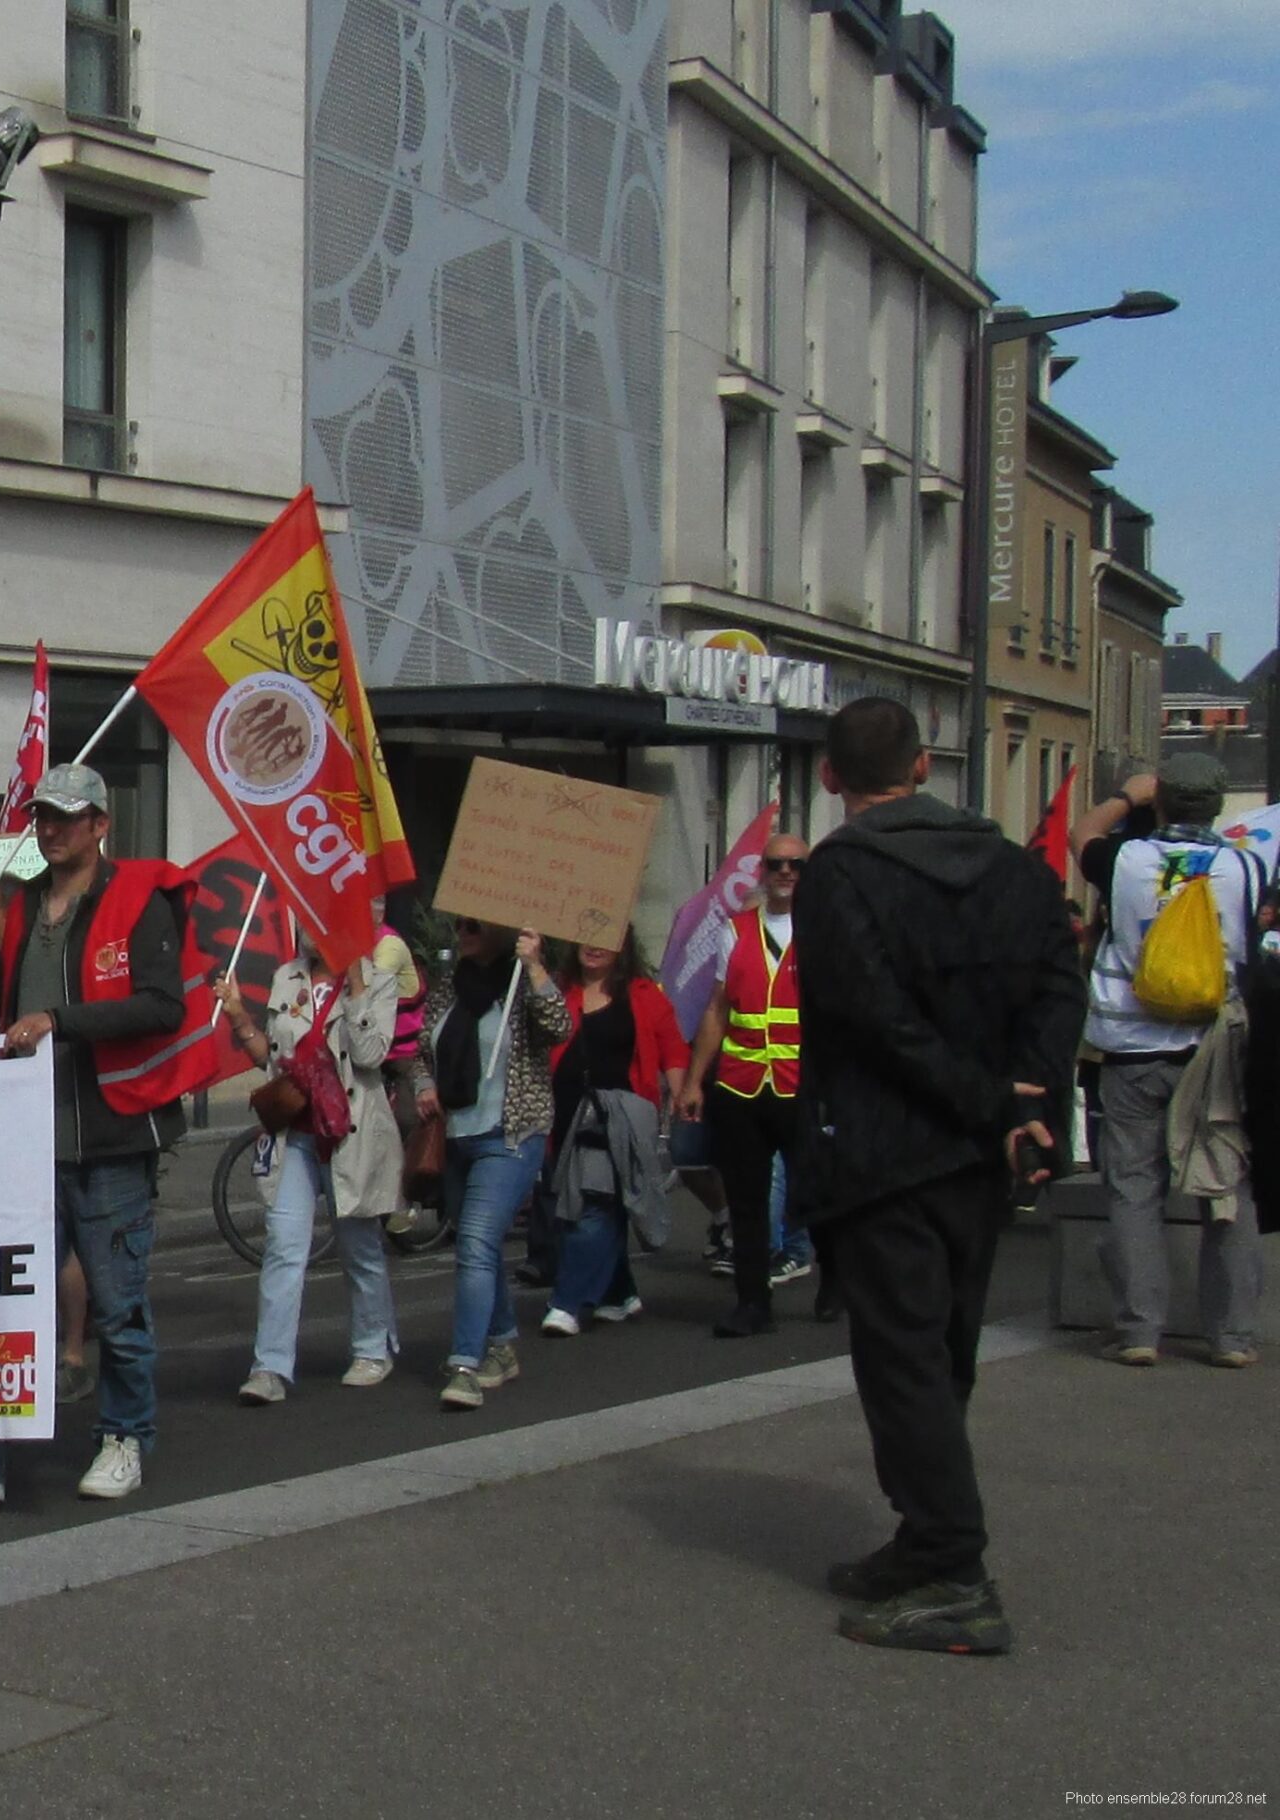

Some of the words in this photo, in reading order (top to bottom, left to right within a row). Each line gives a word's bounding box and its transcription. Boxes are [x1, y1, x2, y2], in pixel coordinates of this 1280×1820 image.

[996, 358, 1017, 446] HOTEL
[989, 456, 1015, 602] Mercure
[286, 794, 368, 894] cgt
